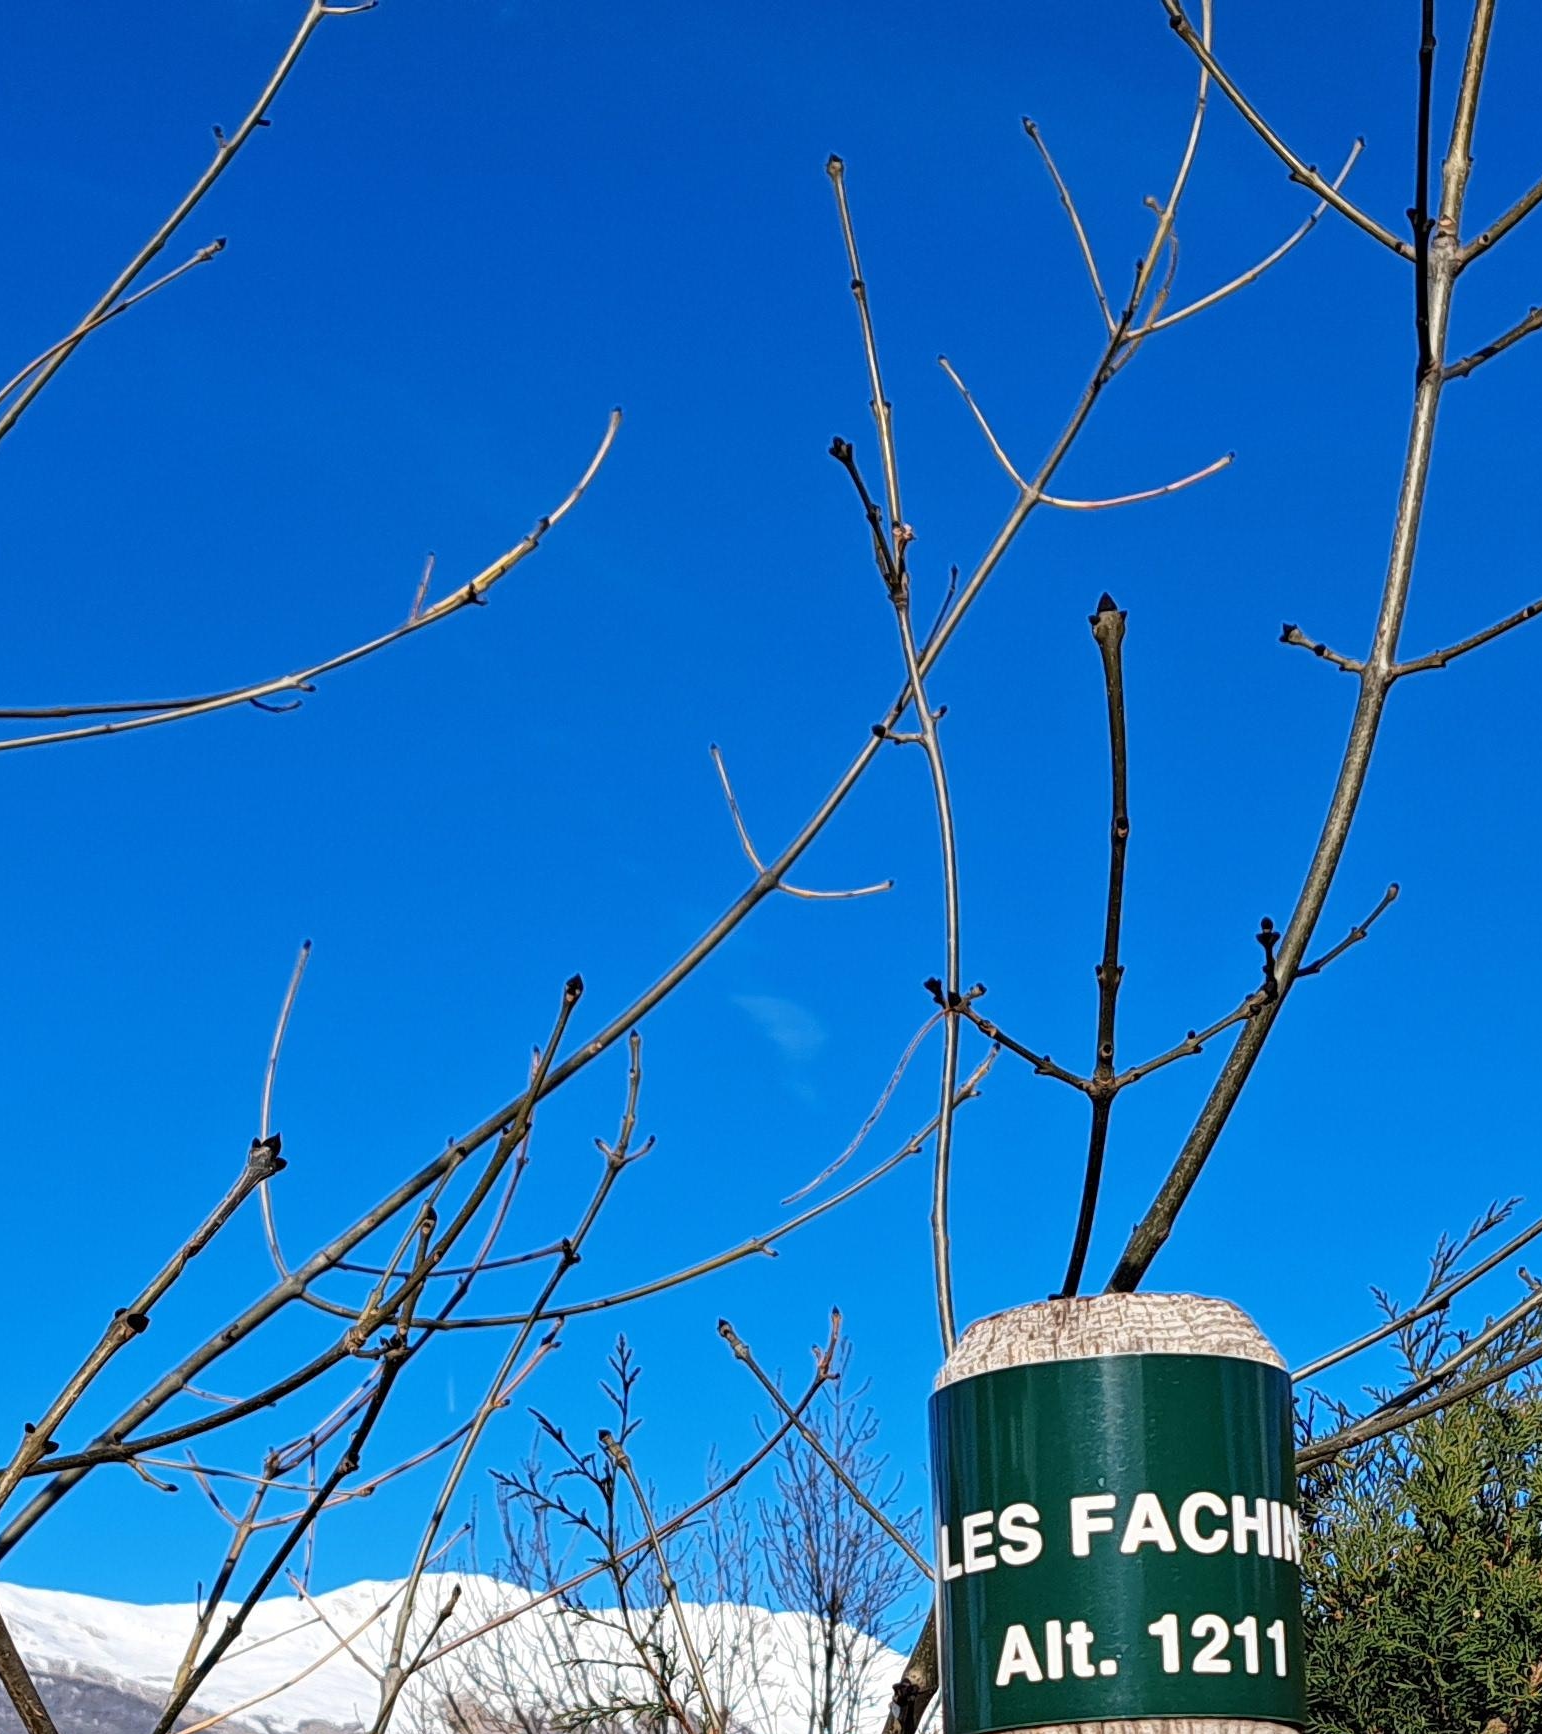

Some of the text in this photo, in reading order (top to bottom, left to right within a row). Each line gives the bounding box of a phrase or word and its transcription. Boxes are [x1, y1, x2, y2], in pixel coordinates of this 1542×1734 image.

[940, 1490, 1301, 1582] LES FACHIN
[995, 1613, 1288, 1687] Alt. 1211
